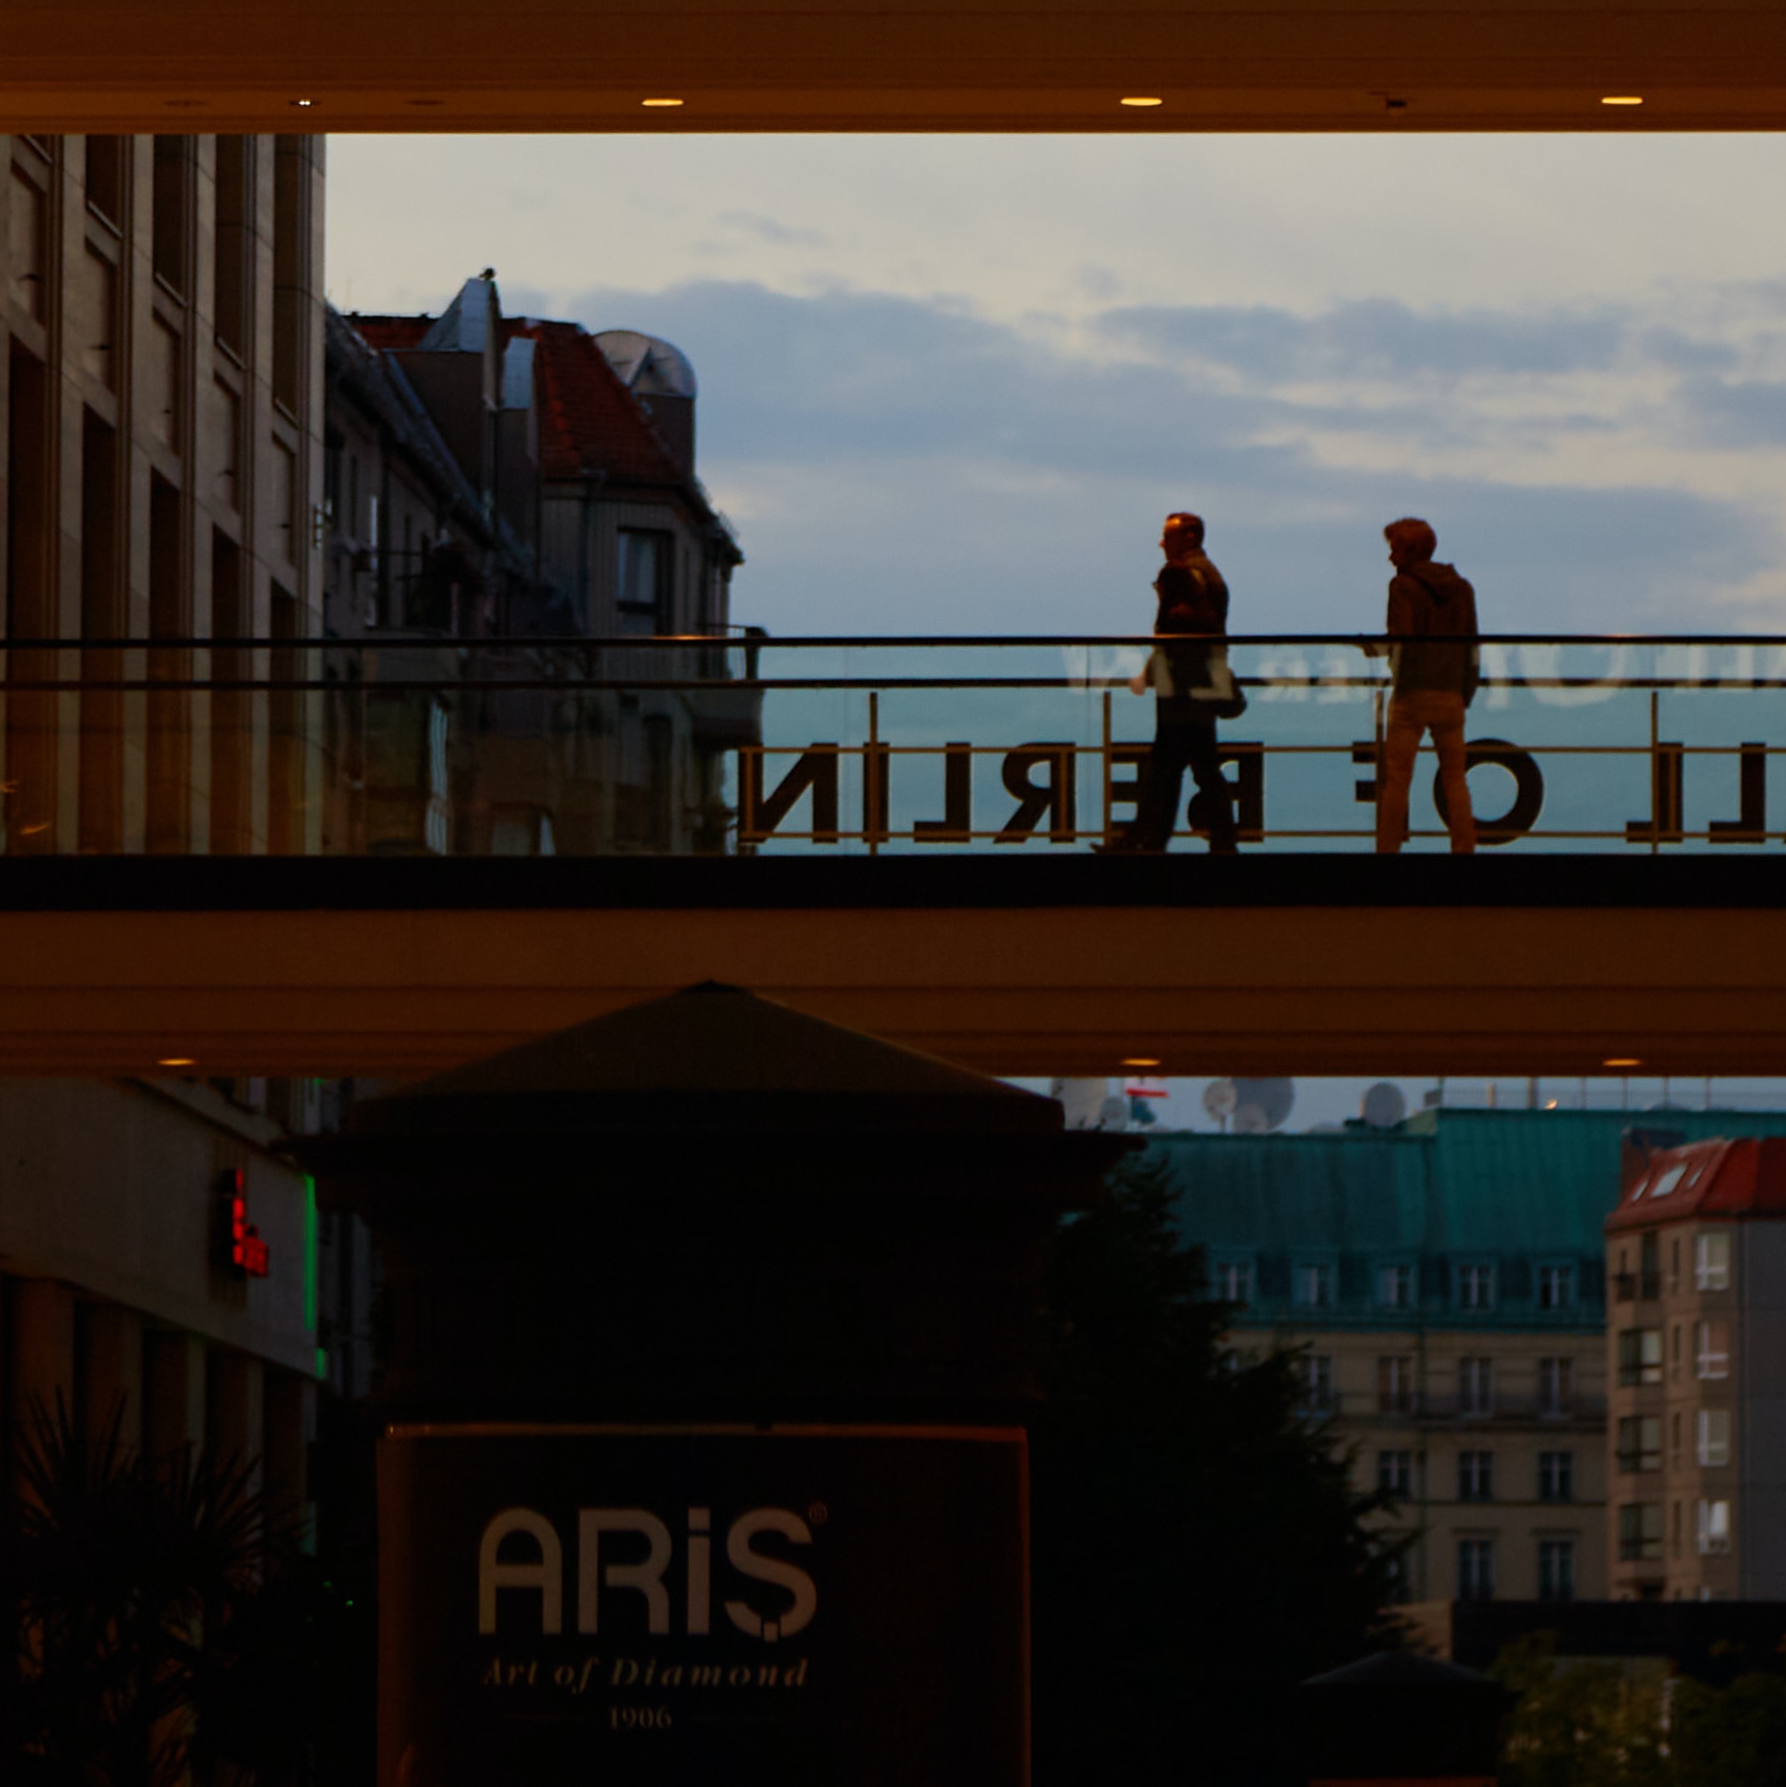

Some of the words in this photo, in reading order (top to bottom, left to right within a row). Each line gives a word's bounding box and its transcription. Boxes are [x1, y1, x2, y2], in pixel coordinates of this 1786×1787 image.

[480, 1654, 540, 1688] Art
[552, 1654, 601, 1696] of
[610, 1653, 811, 1688] Diamond
[608, 1705, 674, 1732] 1906
